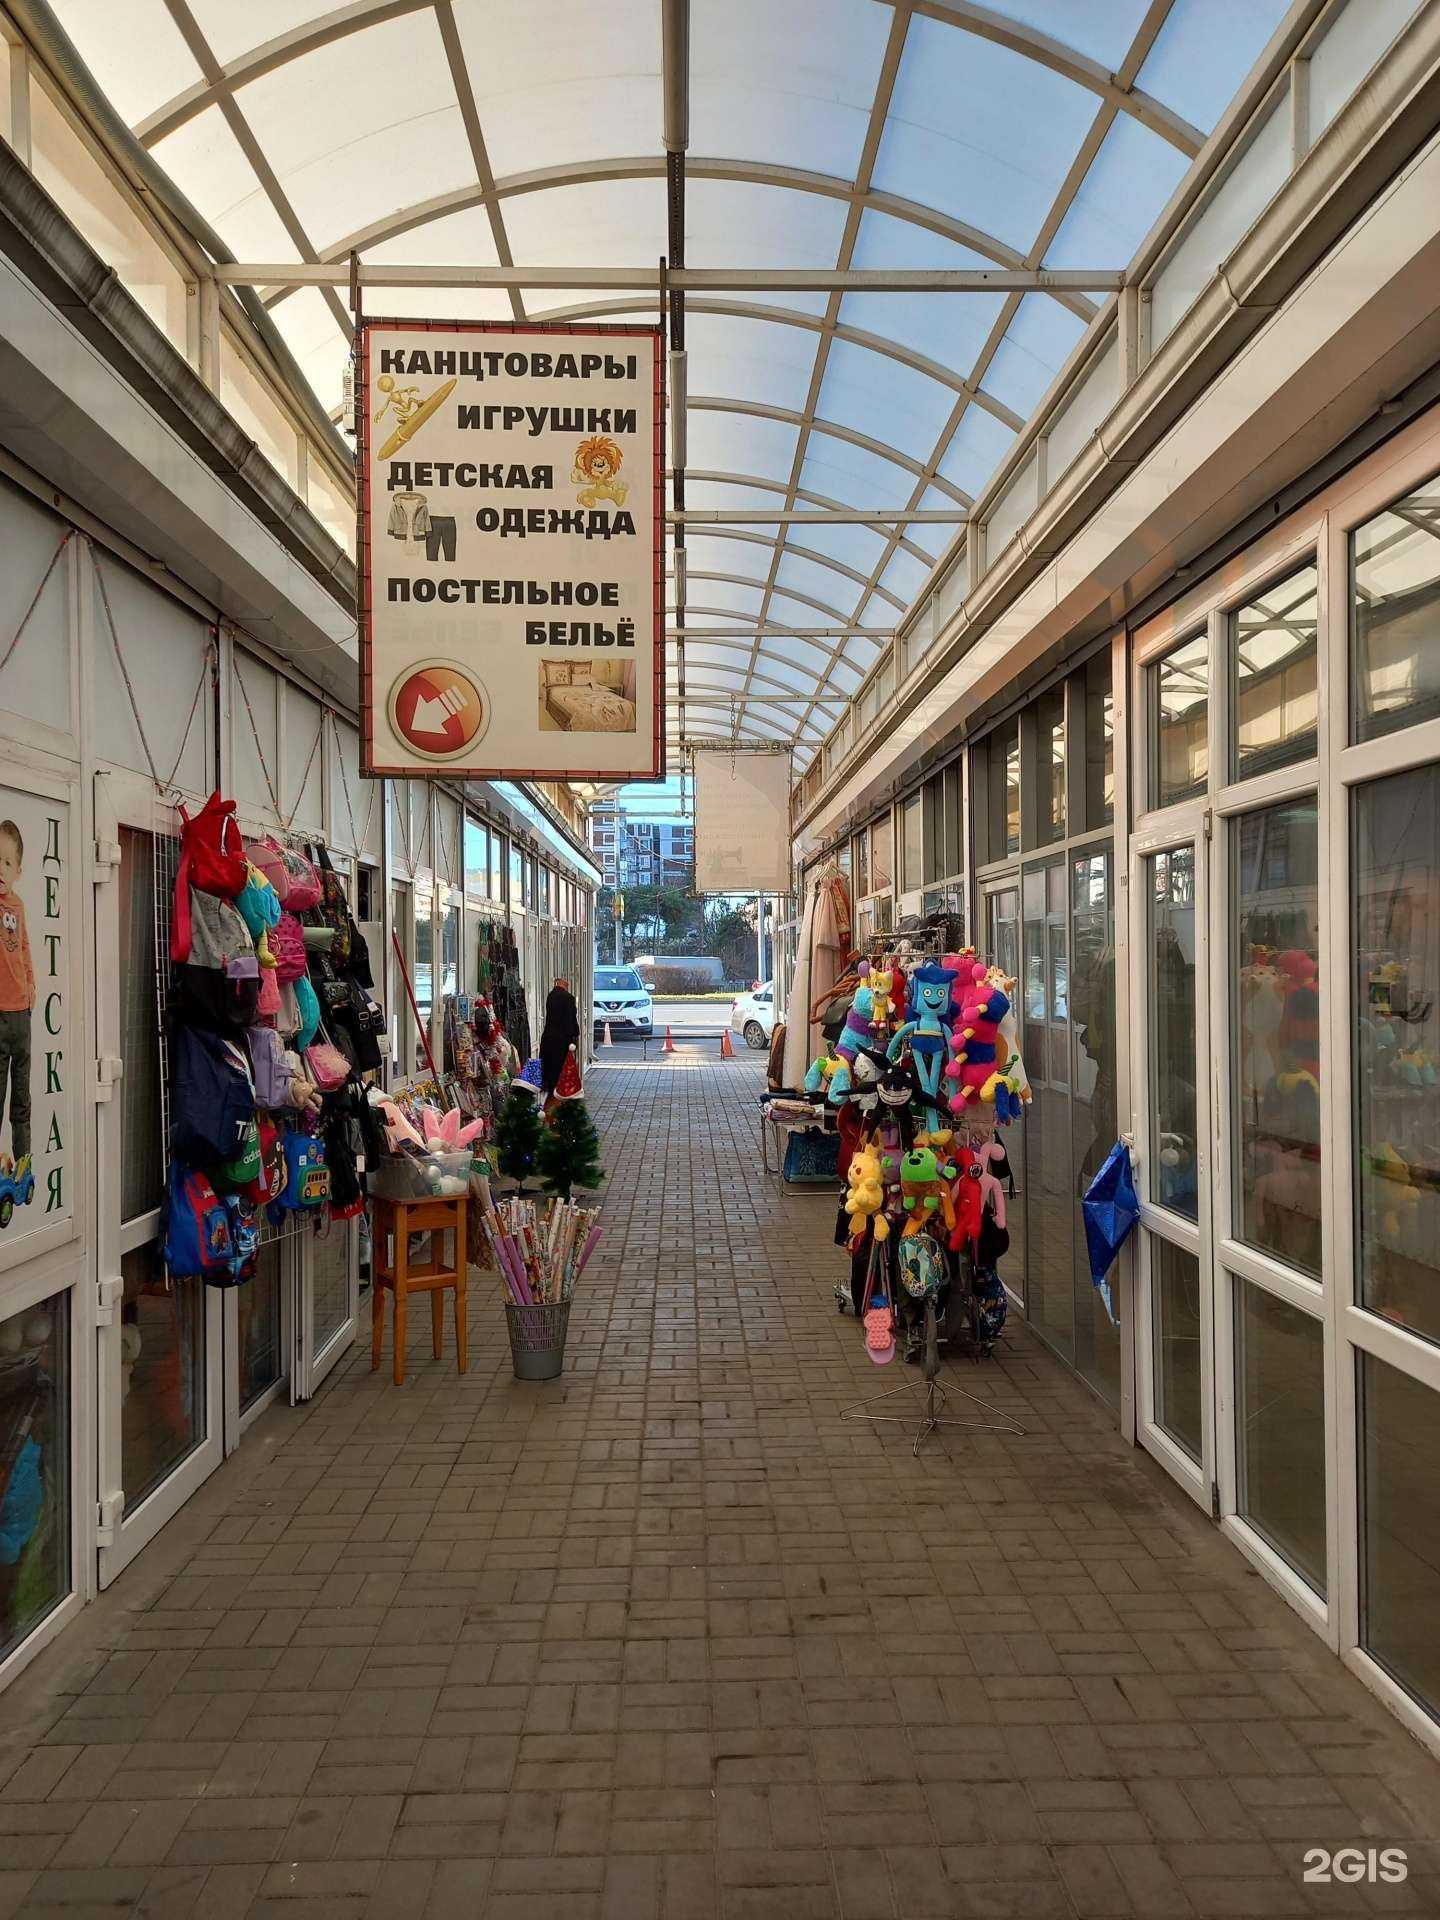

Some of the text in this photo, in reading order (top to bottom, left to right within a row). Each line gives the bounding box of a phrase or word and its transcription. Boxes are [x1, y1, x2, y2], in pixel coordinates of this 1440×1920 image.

[380, 349, 637, 382] КАНЦТОВАРЫ
[457, 404, 637, 435] ИГРУШКИ
[386, 461, 554, 493] ДЕТСКАЯ
[475, 507, 637, 541] ОДЕЖДА
[387, 577, 619, 607] ПОСТЕЛЬНОЕ
[525, 616, 635, 647] БЕЛЬЁ
[42, 817, 64, 1214] ДЕТСКАЯ
